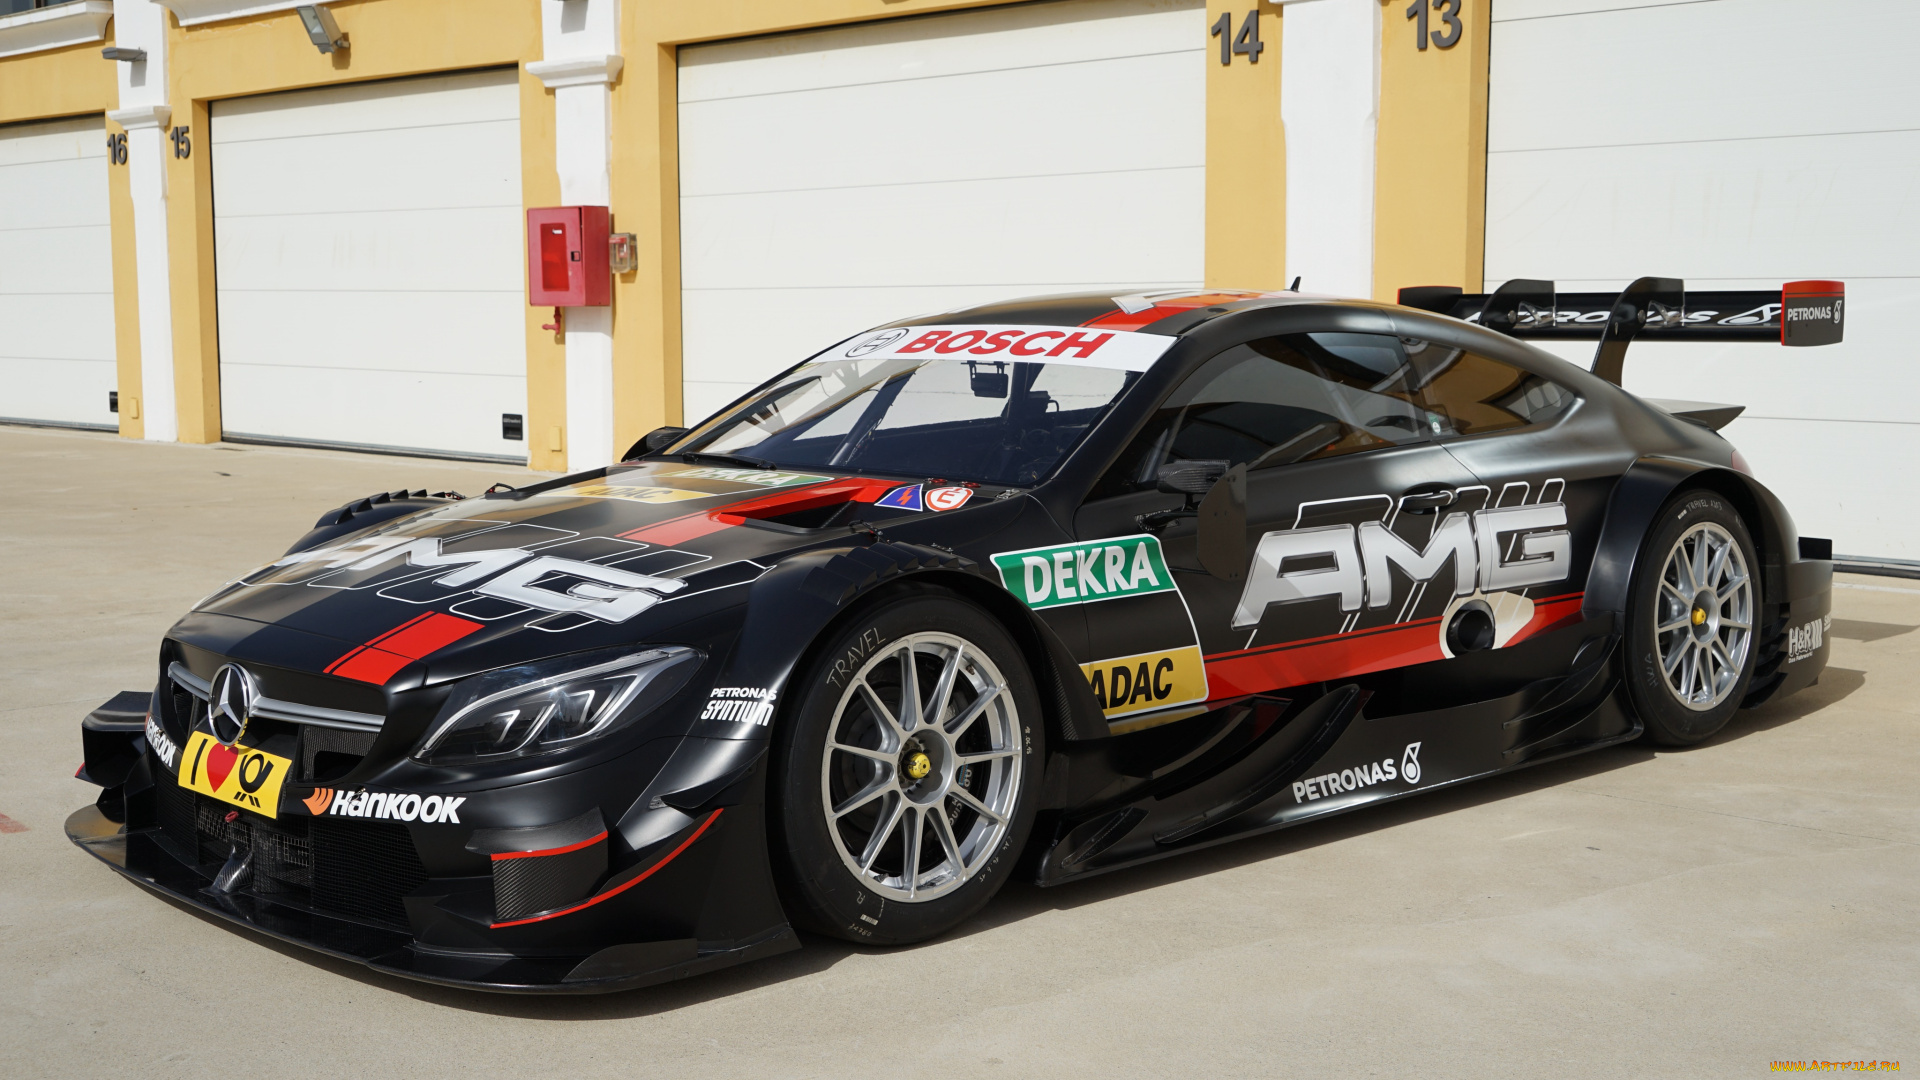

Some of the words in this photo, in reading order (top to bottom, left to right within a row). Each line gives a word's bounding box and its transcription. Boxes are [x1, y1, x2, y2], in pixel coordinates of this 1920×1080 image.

[1211, 10, 1264, 66] 14
[1406, 0, 1463, 51] 13
[107, 133, 128, 165] 16
[170, 126, 191, 159] 15
[1787, 306, 1832, 321] PETRONAS
[895, 330, 1116, 358] BOSCH
[272, 534, 688, 624] AMG
[1022, 541, 1160, 604] DEKRA
[1231, 500, 1572, 631] AMG
[826, 627, 887, 689] TRAVEL
[1789, 622, 1812, 657] H&R
[710, 687, 778, 700] PETRONAS
[1090, 657, 1174, 710] ADAC
[701, 700, 775, 727] SYNTIUM
[1292, 758, 1398, 804] PETRONAS
